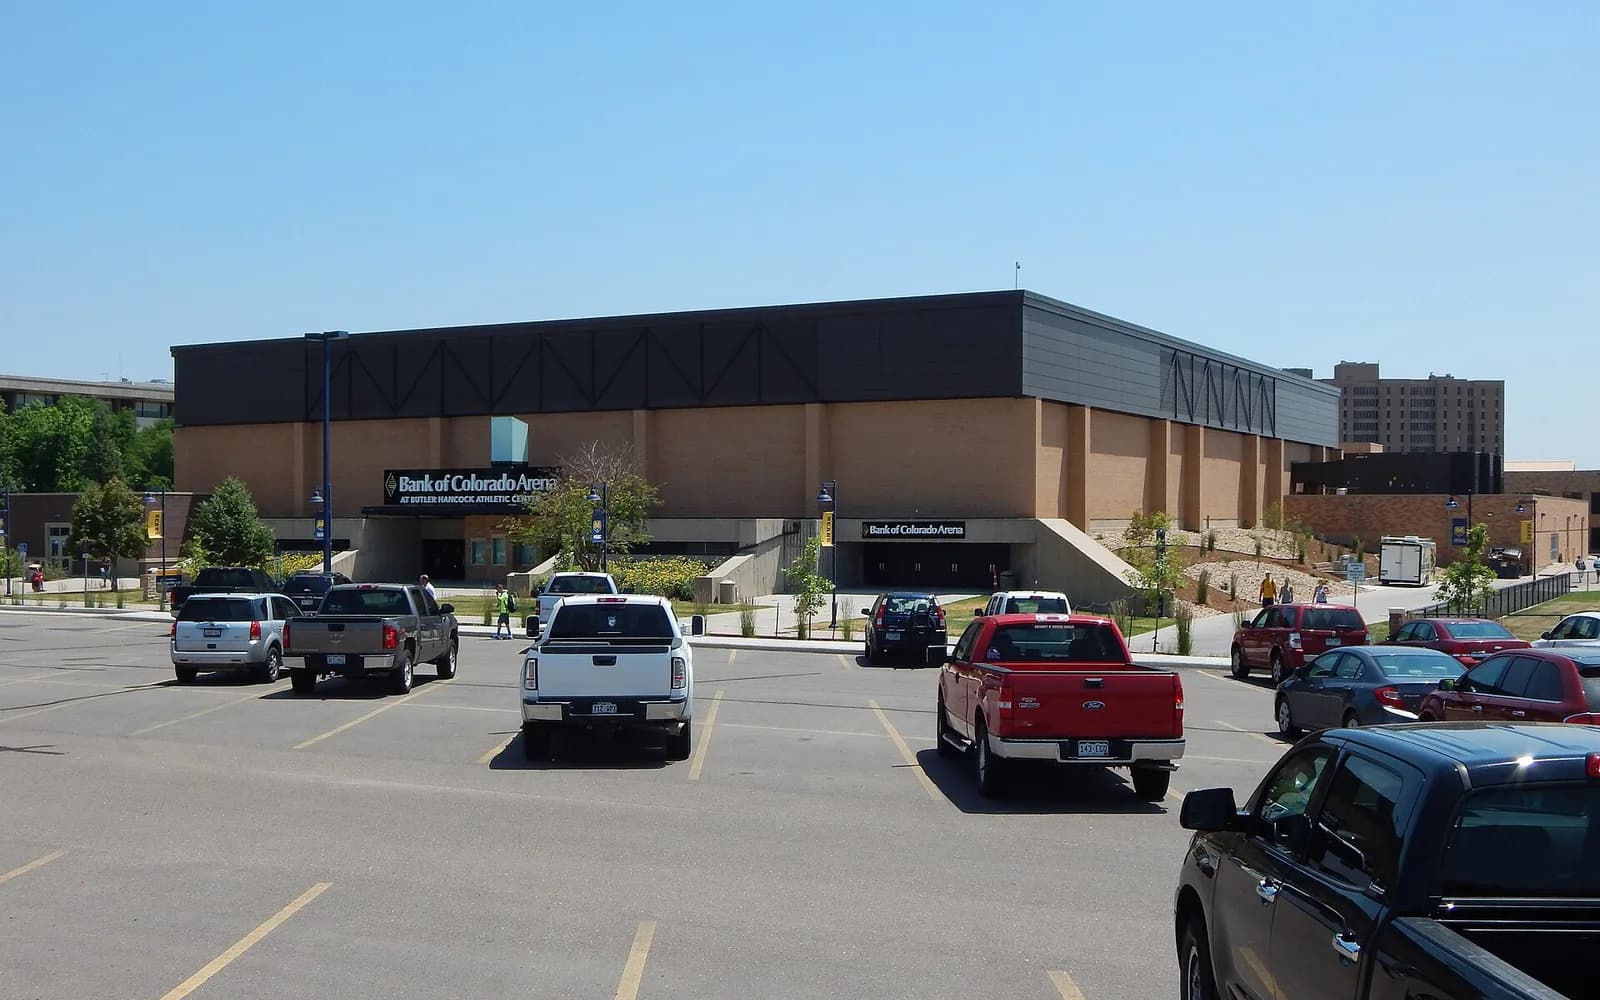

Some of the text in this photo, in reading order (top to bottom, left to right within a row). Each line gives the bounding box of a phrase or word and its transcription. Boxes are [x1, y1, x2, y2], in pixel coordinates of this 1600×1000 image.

[399, 473, 557, 492] Bank of Colorado Arena
[400, 496, 410, 504] AT
[410, 496, 438, 504] BUTLER
[438, 495, 475, 503] HANCOCK
[475, 495, 510, 503] ATHLETIC
[869, 524, 964, 535] Bank of Colorado Arena
